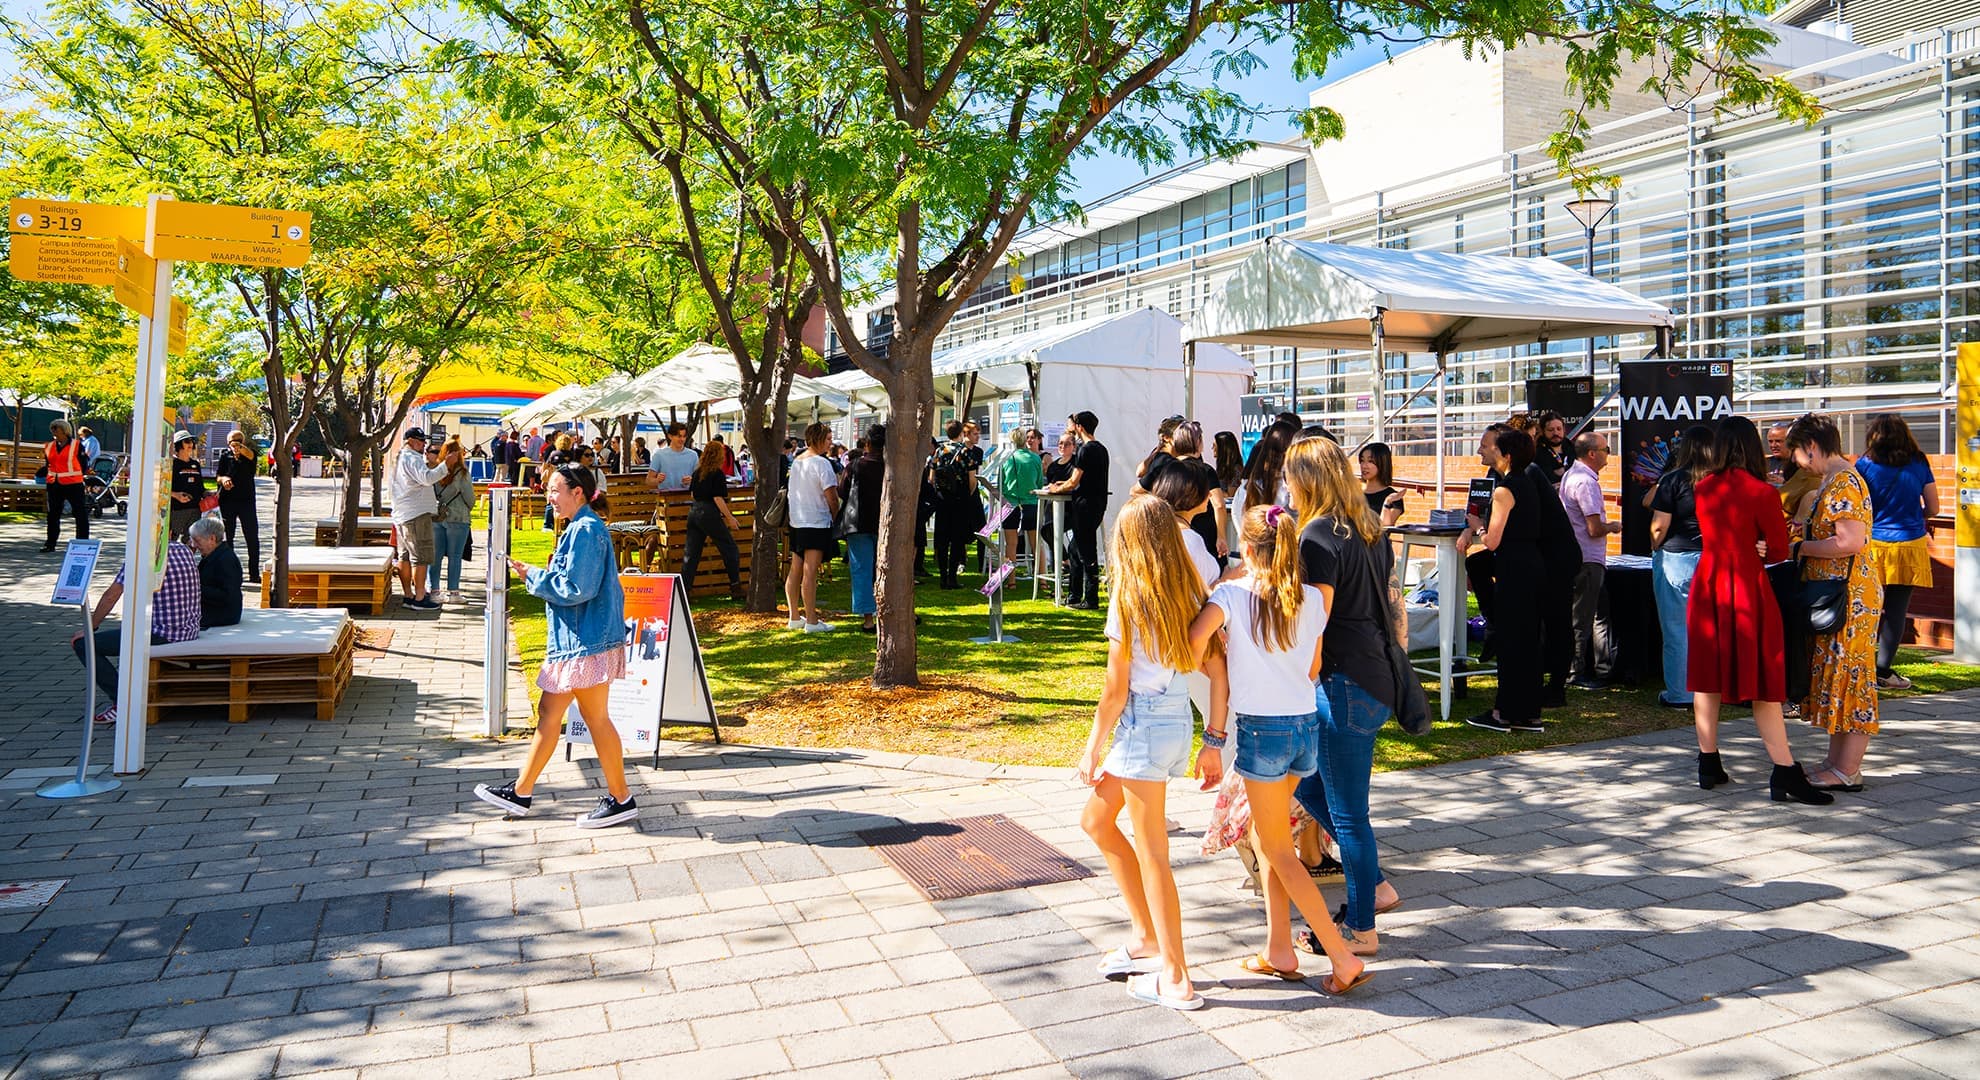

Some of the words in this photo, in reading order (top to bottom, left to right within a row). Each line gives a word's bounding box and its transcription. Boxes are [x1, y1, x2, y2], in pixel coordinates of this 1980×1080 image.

[40, 205, 78, 215] Buildings
[39, 215, 82, 231] 3-19
[250, 212, 284, 223] Building
[271, 224, 281, 239] 1
[40, 239, 70, 248] Campus
[39, 247, 69, 256] Campus
[70, 248, 100, 257] Support
[252, 246, 282, 255] WAAPA
[210, 252, 241, 261] WAAPA
[258, 255, 282, 264] Office
[67, 265, 104, 274] Spectrum
[37, 271, 67, 280] Student
[68, 273, 84, 281] Hub
[1711, 363, 1727, 374] ECU
[1620, 395, 1734, 420] WAAPA
[1241, 414, 1276, 433] WAAP
